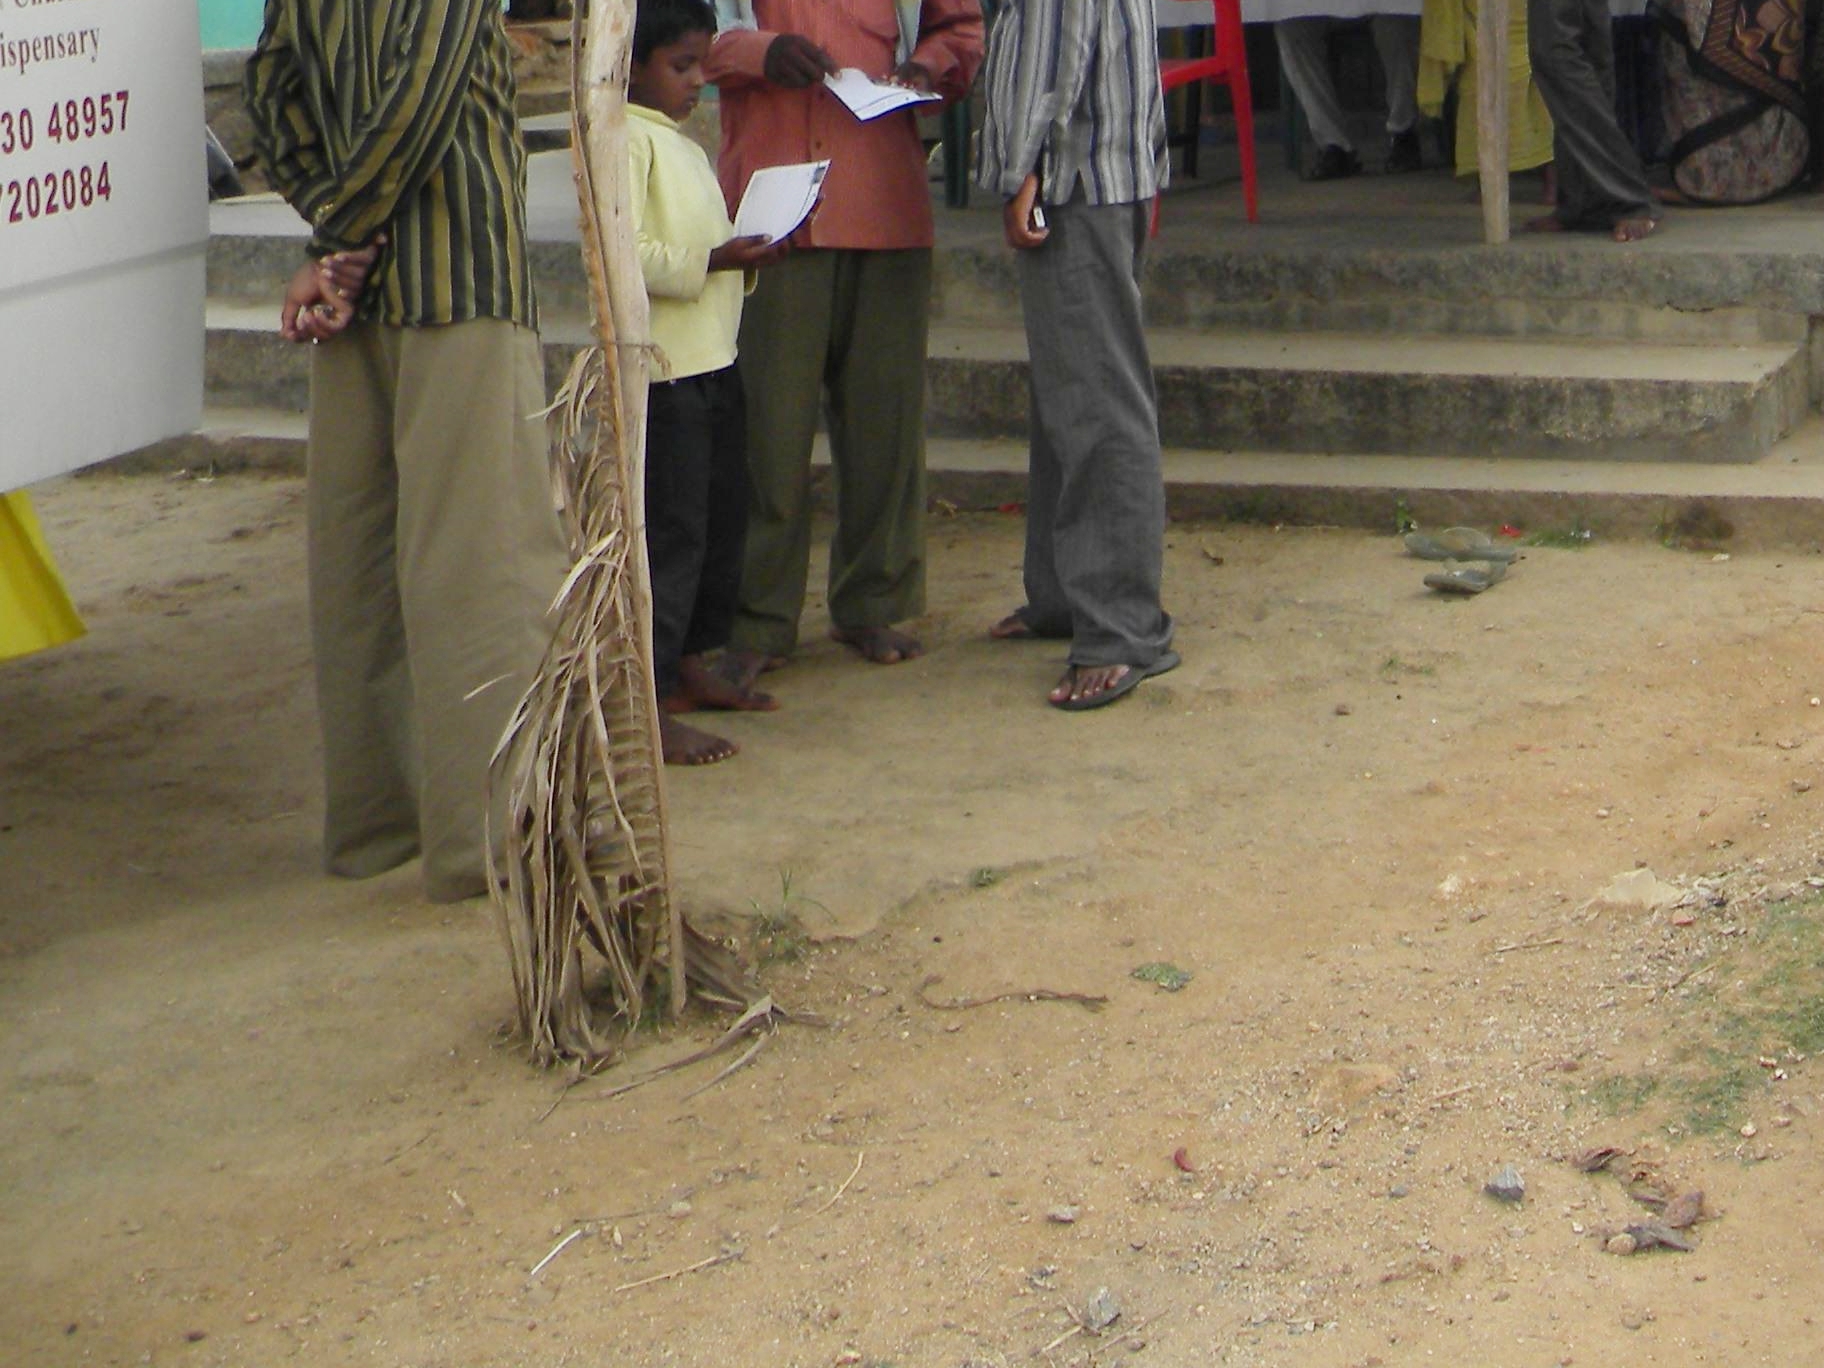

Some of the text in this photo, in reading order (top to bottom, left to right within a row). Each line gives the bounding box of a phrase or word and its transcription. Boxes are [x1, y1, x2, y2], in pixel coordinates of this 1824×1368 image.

[0, 26, 102, 75] ispensary
[48, 89, 130, 144] 48957
[0, 160, 113, 224] 202084
